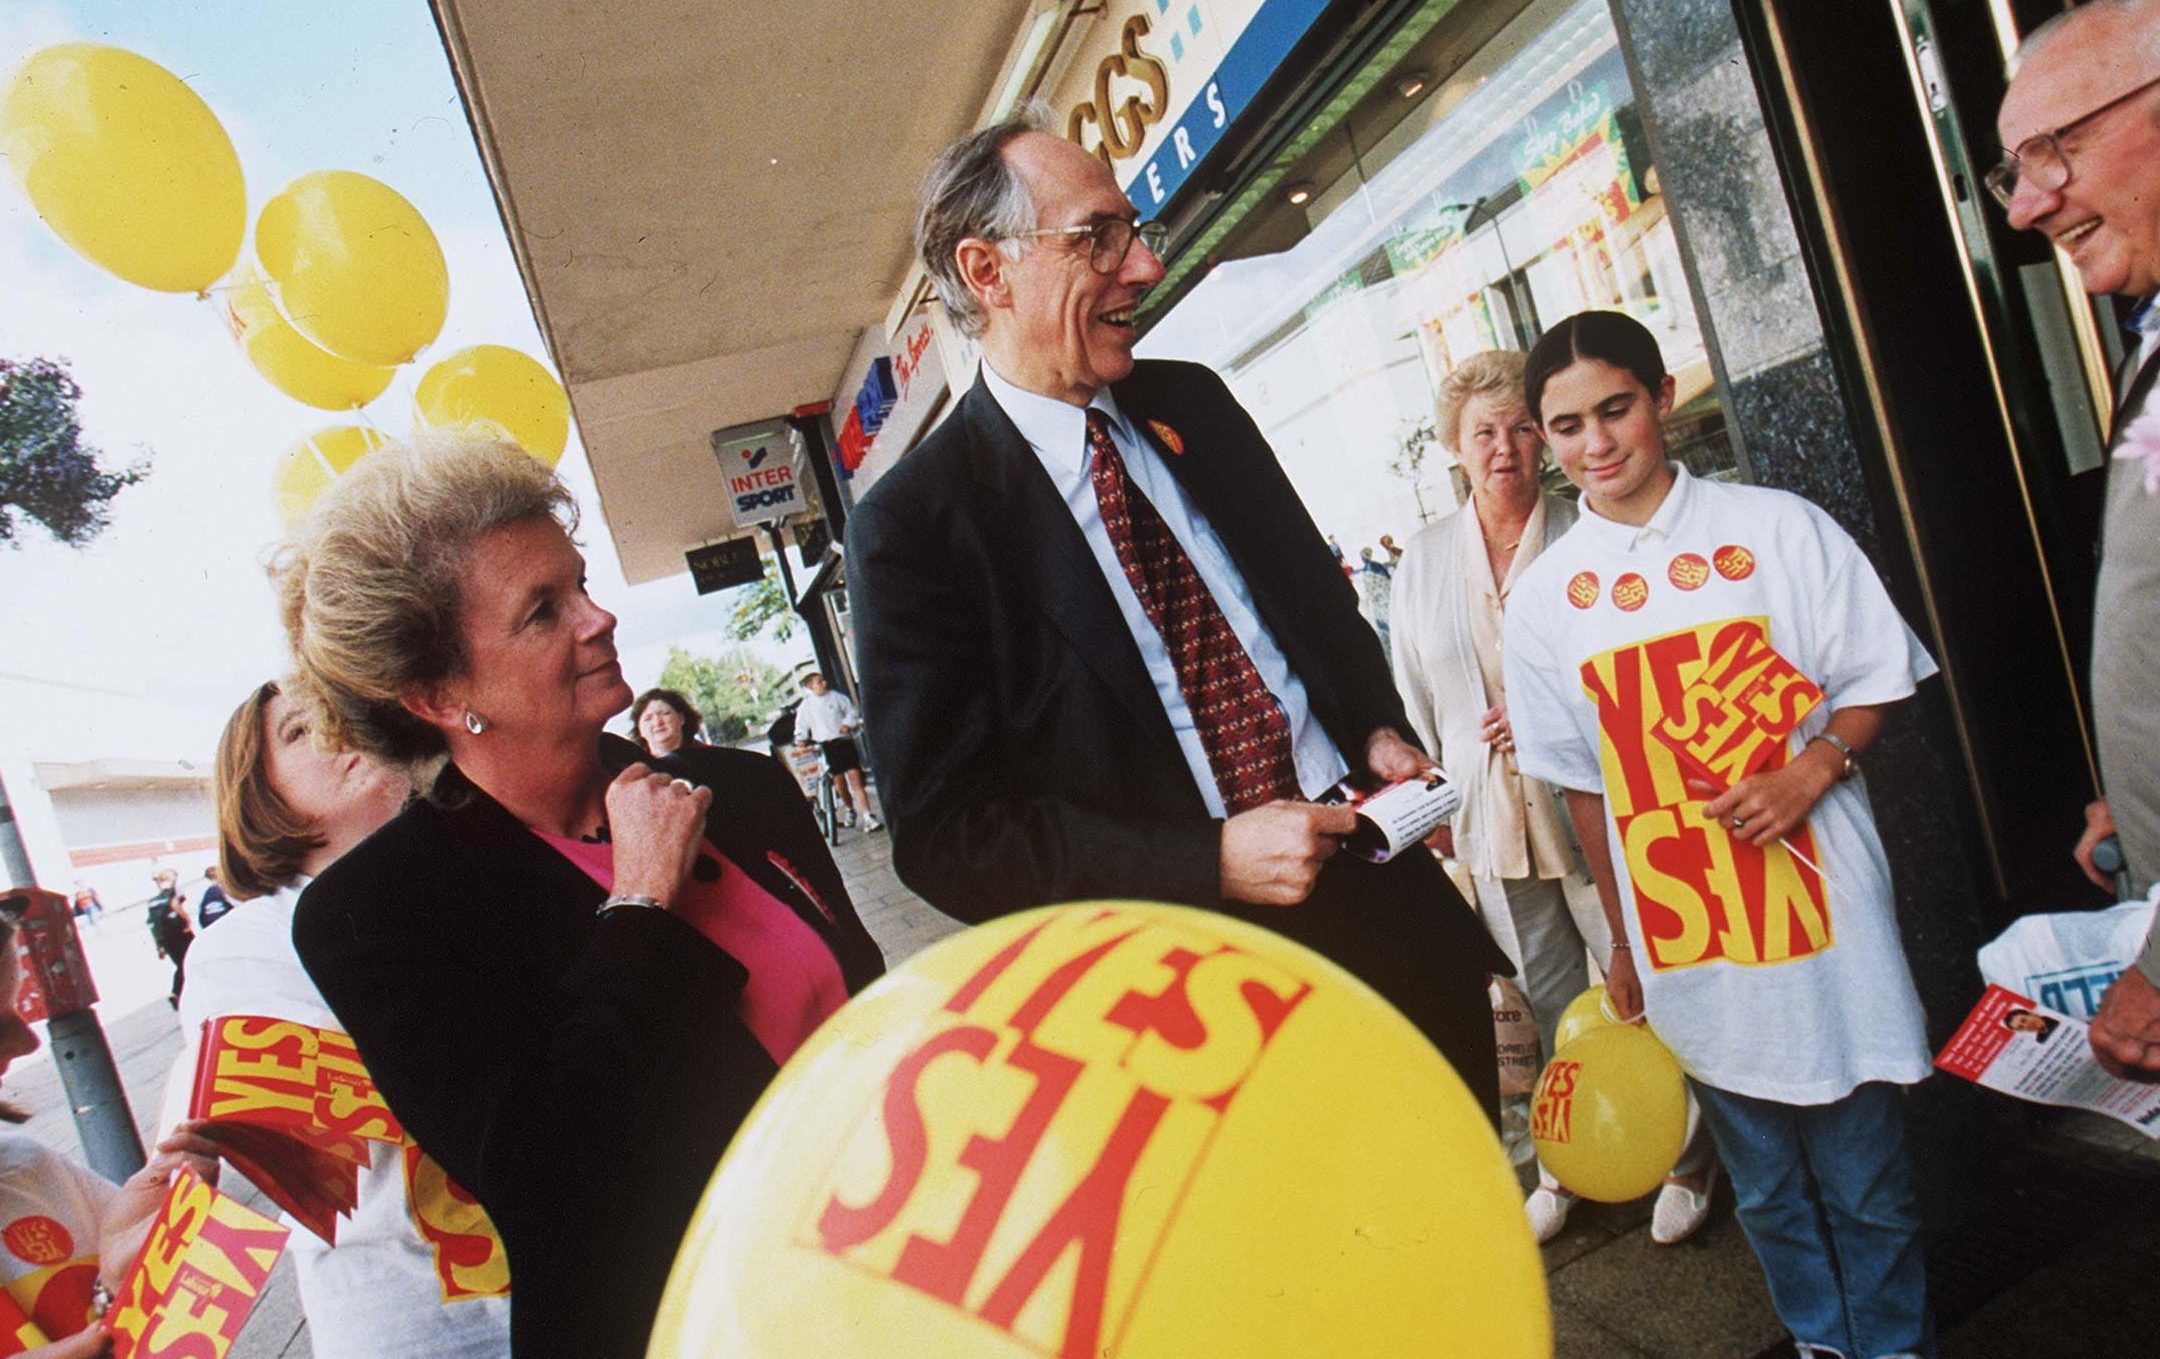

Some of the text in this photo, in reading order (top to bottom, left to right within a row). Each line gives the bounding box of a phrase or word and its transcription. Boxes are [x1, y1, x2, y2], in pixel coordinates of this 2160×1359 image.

[1127, 82, 1226, 204] ERS
[731, 465, 792, 494] INTER
[736, 483, 796, 513] SPORT
[964, 904, 1303, 1100] YES
[208, 1018, 320, 1118] YES
[1537, 1061, 1582, 1099] YES
[818, 1025, 1174, 1359] YES
[113, 1173, 214, 1341] YES
